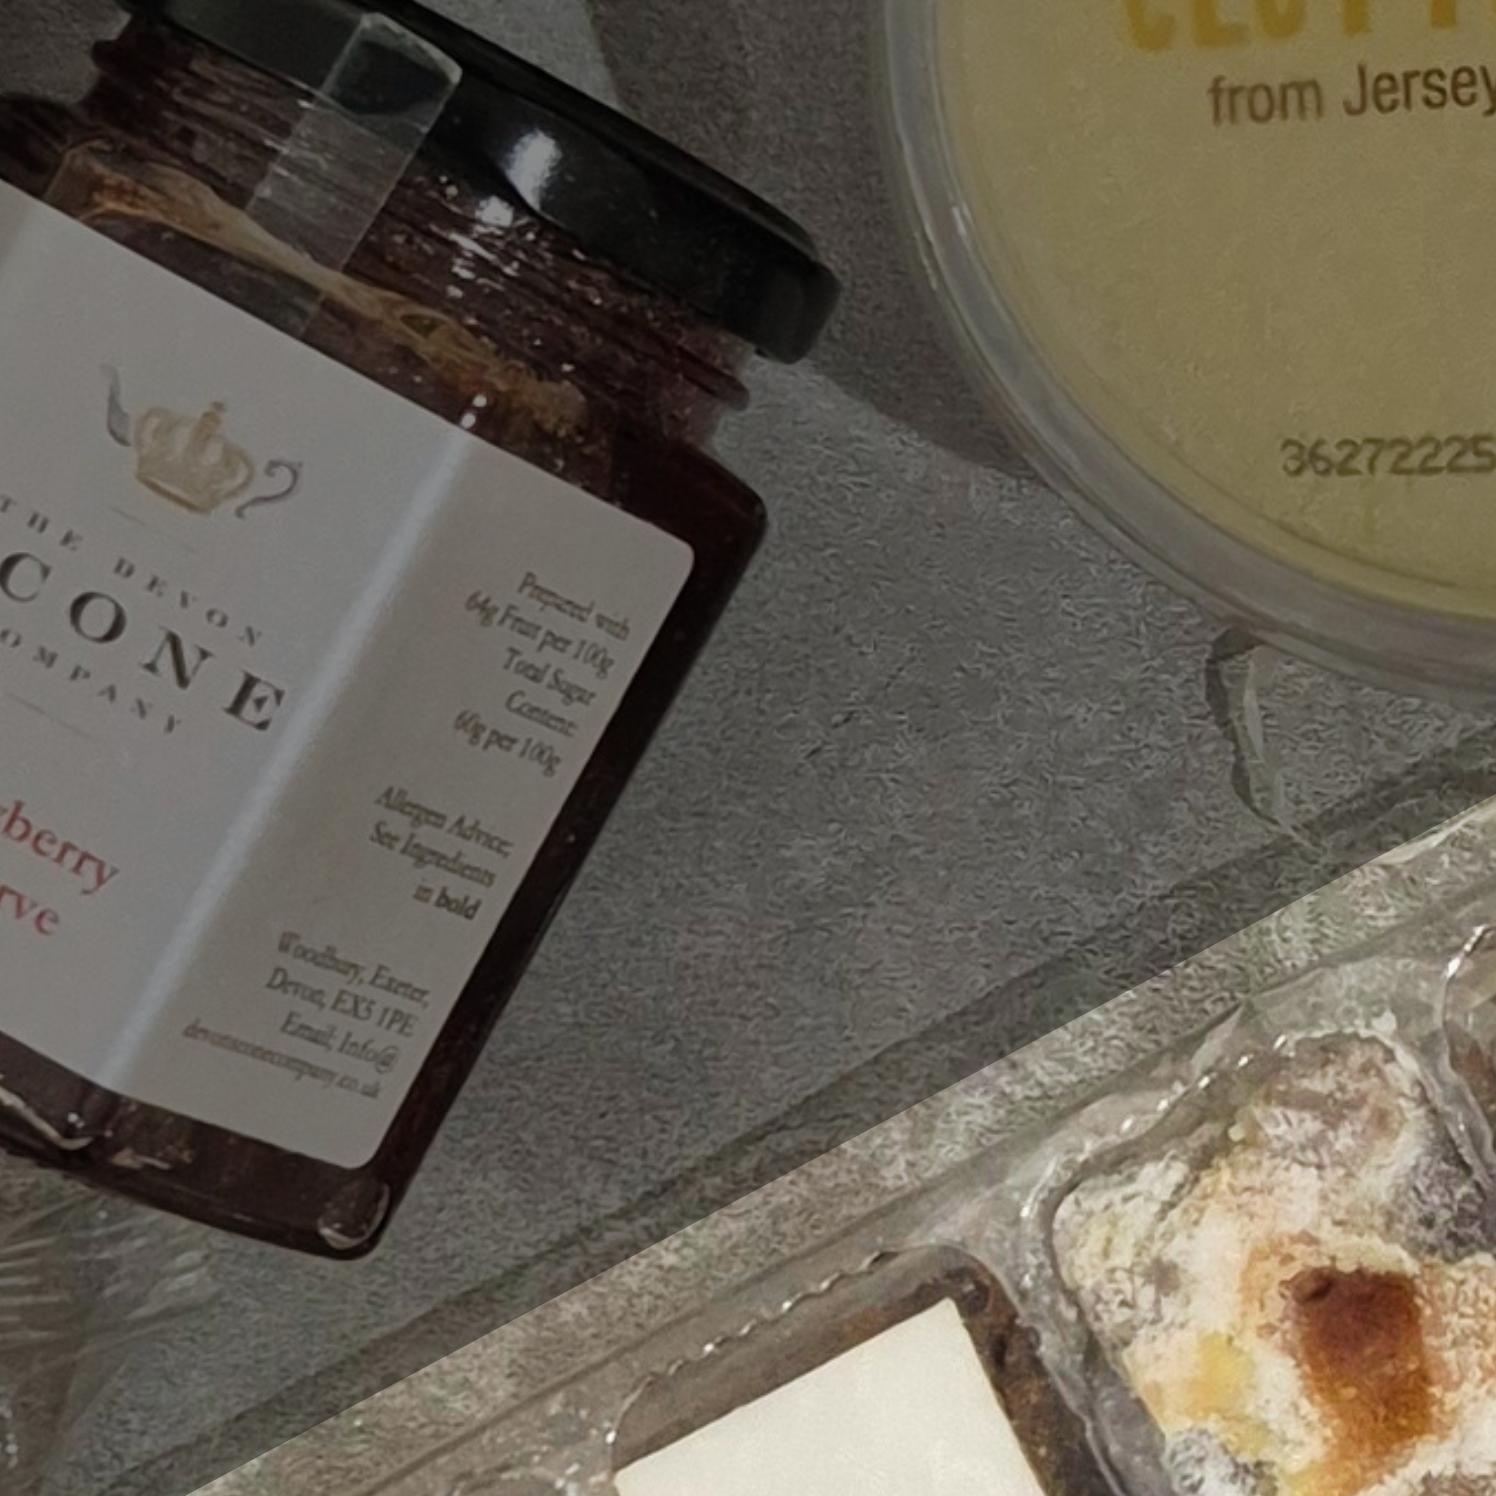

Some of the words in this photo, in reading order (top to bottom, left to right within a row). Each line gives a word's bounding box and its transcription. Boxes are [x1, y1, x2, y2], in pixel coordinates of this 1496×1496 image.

[1207, 73, 1324, 127] from
[113, 557, 263, 647] DEVON
[517, 571, 596, 624] Prepared
[595, 612, 631, 642] with
[464, 590, 500, 628] 64g
[536, 629, 573, 653] per
[572, 639, 616, 680] 100g
[502, 646, 551, 684] Total
[546, 667, 597, 707] Sugar
[453, 708, 488, 746] 60g
[481, 728, 519, 751] per
[518, 736, 561, 778] 100g
[374, 785, 448, 831] Allergen
[0, 798, 120, 896] berry
[368, 819, 401, 851] See
[399, 832, 498, 889] Ingredients
[412, 877, 435, 903] in
[434, 886, 483, 922] bold
[330, 988, 378, 1032] EX5
[376, 1006, 420, 1038] 1PE
[338, 1032, 399, 1075] Info@
